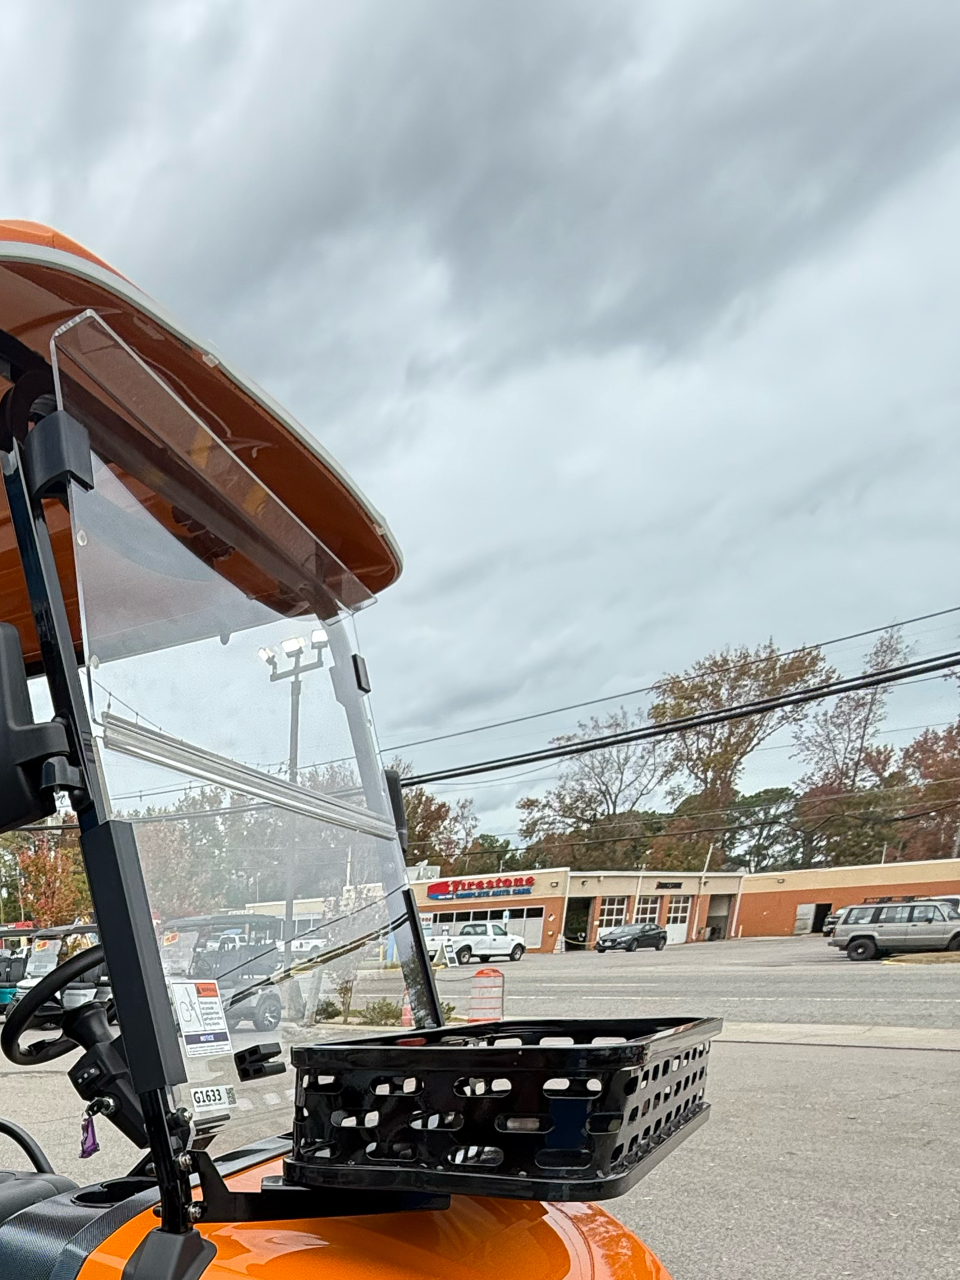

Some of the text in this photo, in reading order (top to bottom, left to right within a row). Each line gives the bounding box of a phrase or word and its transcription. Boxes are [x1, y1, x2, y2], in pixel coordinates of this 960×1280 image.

[451, 876, 535, 893] Firestone
[492, 889, 511, 897] AUTO
[513, 887, 532, 895] CARE
[200, 1034, 215, 1042] NOTICE
[193, 1088, 222, 1104] G1633
